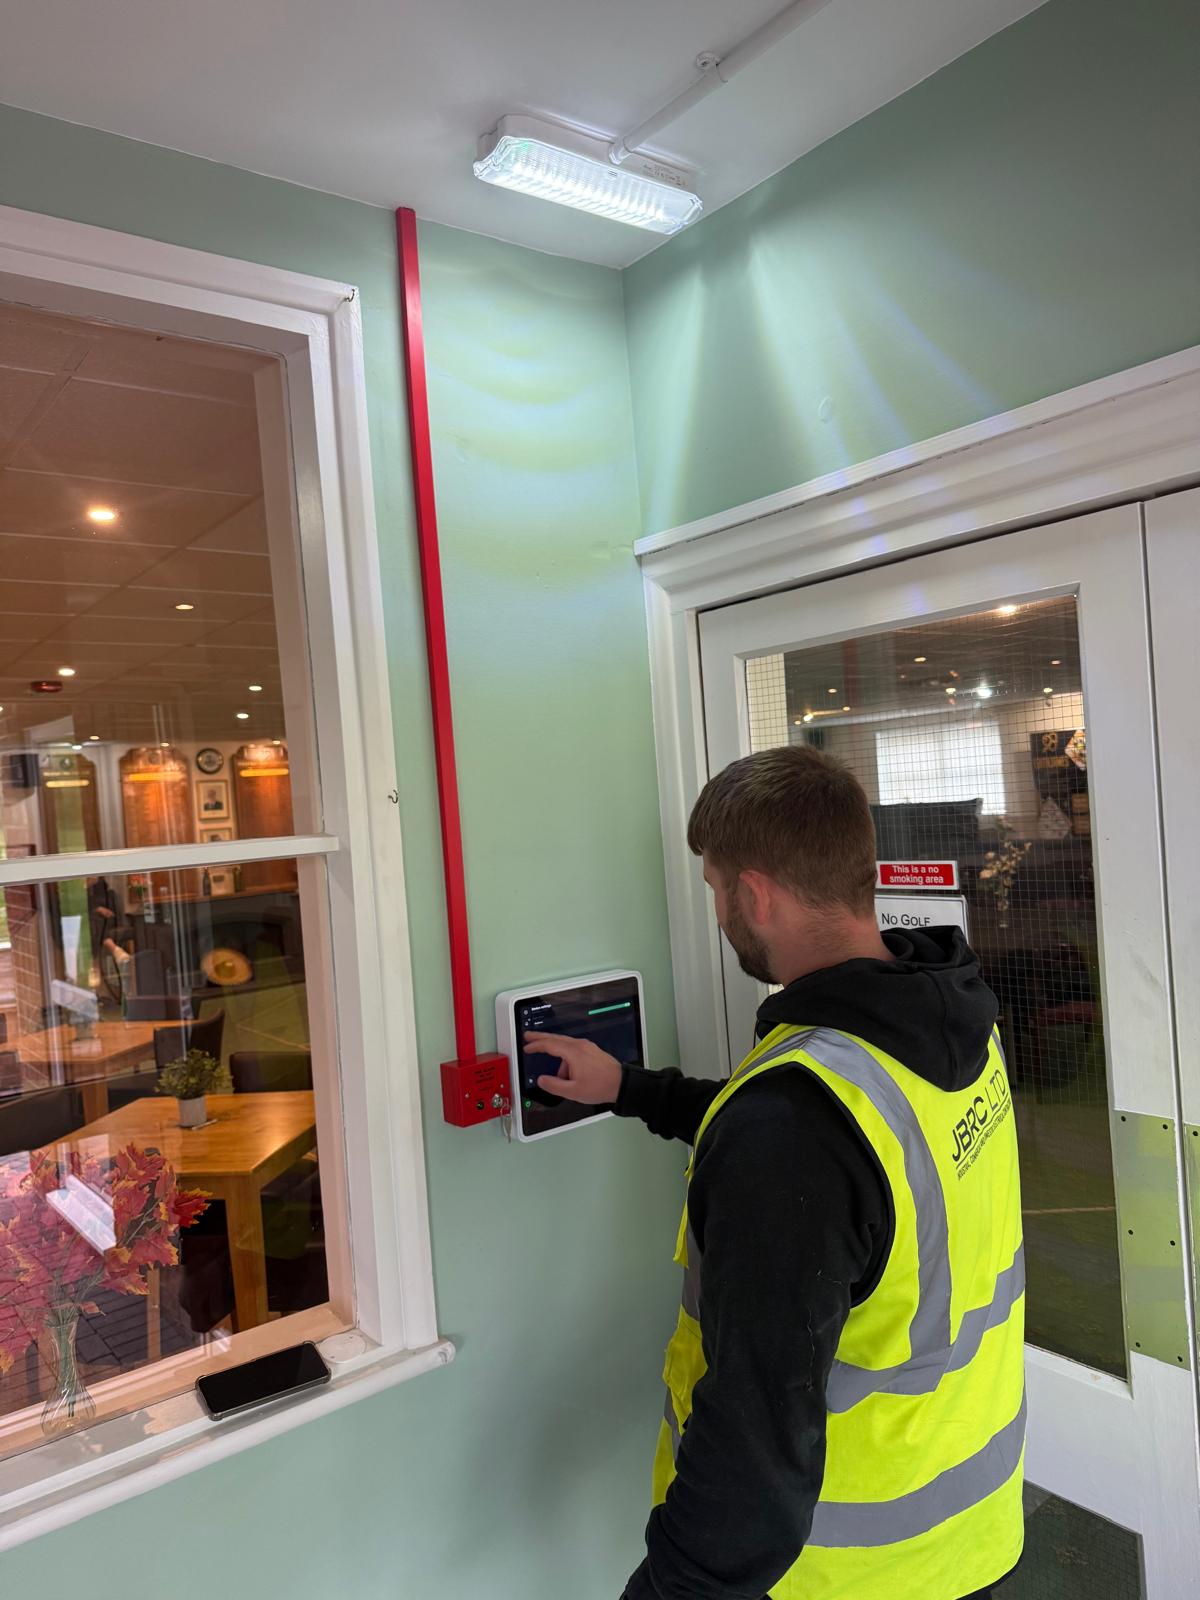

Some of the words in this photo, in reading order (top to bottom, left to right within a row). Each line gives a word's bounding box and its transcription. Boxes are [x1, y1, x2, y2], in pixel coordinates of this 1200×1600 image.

[892, 865, 909, 874] This
[912, 865, 919, 874] is
[889, 874, 924, 885] smoking
[925, 875, 944, 884] area
[952, 1096, 988, 1162] JBRC
[985, 1069, 1006, 1112] LTD
